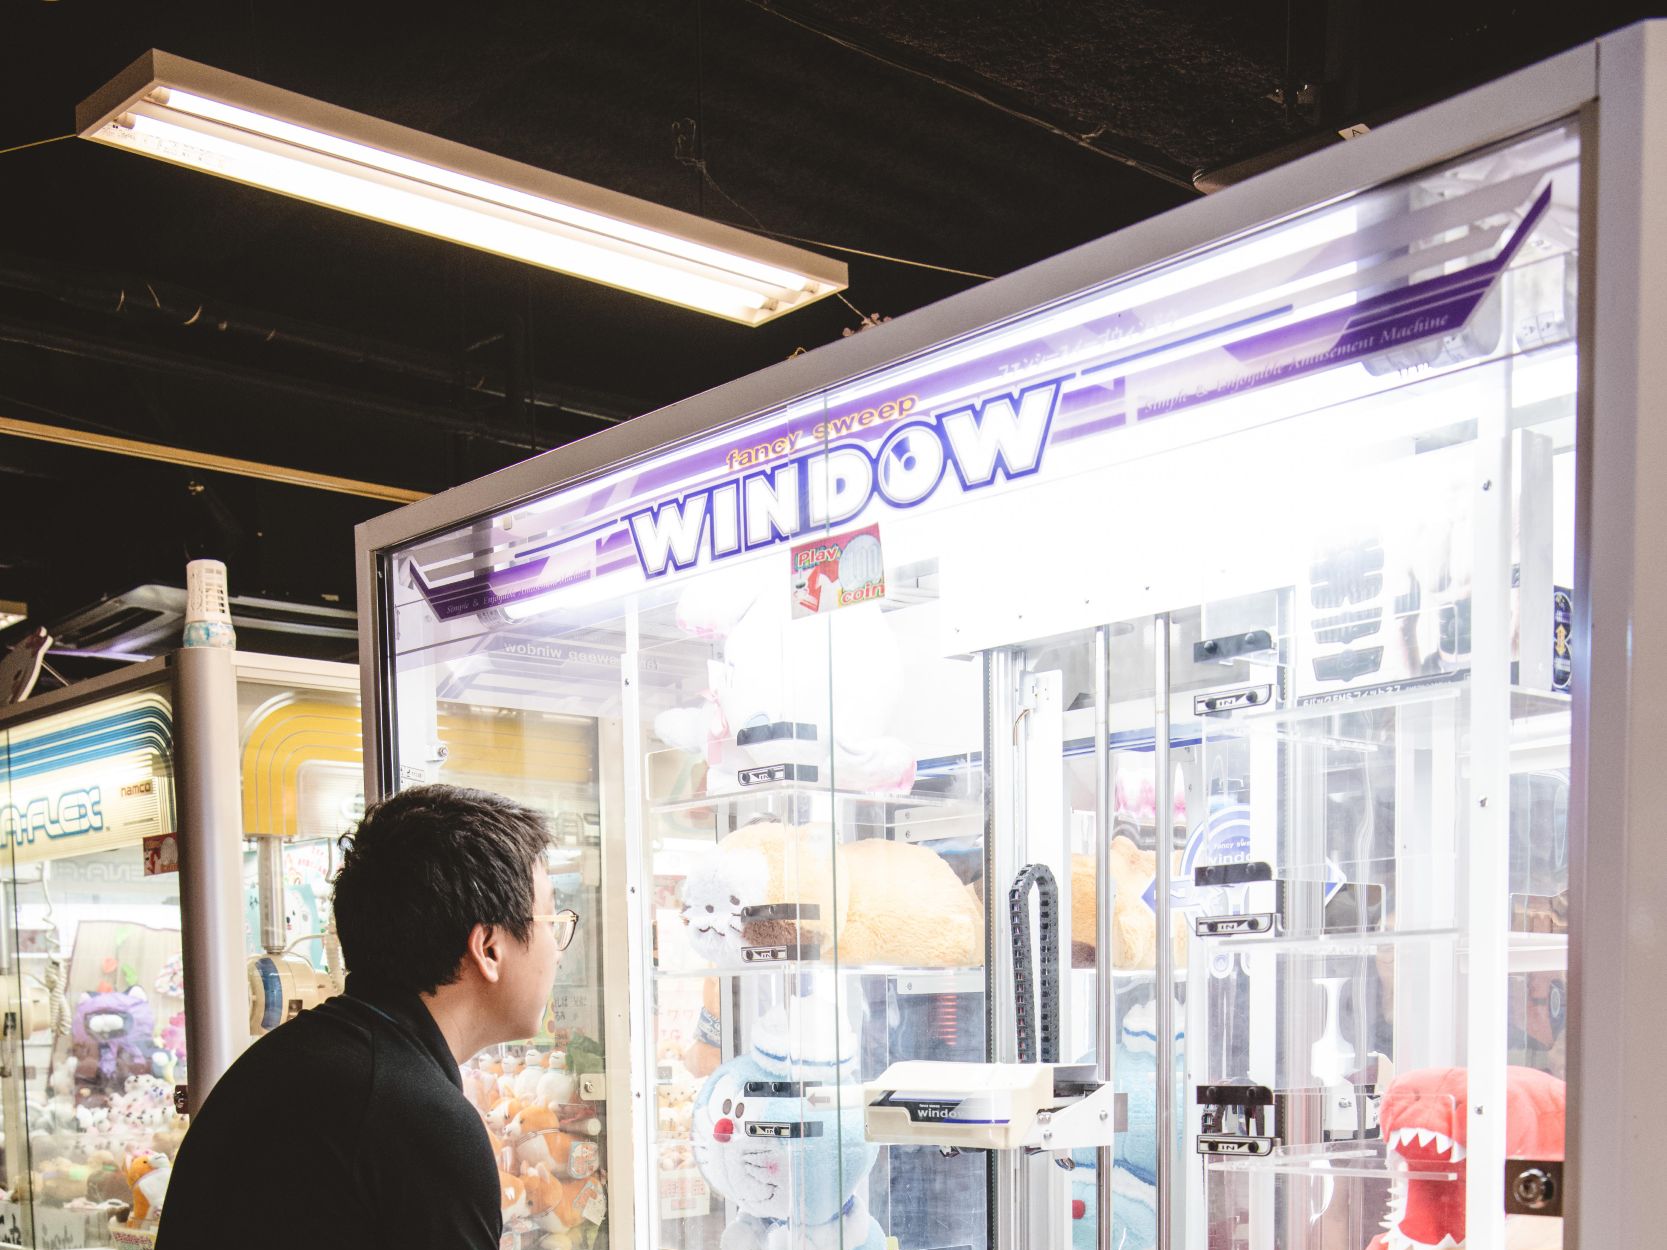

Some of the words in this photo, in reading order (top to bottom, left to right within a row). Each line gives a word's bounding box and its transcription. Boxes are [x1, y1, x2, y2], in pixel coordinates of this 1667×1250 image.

[1145, 389, 1188, 413] Simple
[1217, 362, 1284, 395] Enjoyable
[1289, 336, 1375, 371] Amusement
[1381, 314, 1449, 343] Machine
[726, 429, 803, 471] fancy
[811, 394, 919, 441] sweep
[626, 381, 1065, 580] WINDOW
[797, 545, 838, 567] Play
[841, 583, 885, 605] coin
[120, 781, 151, 798] namco
